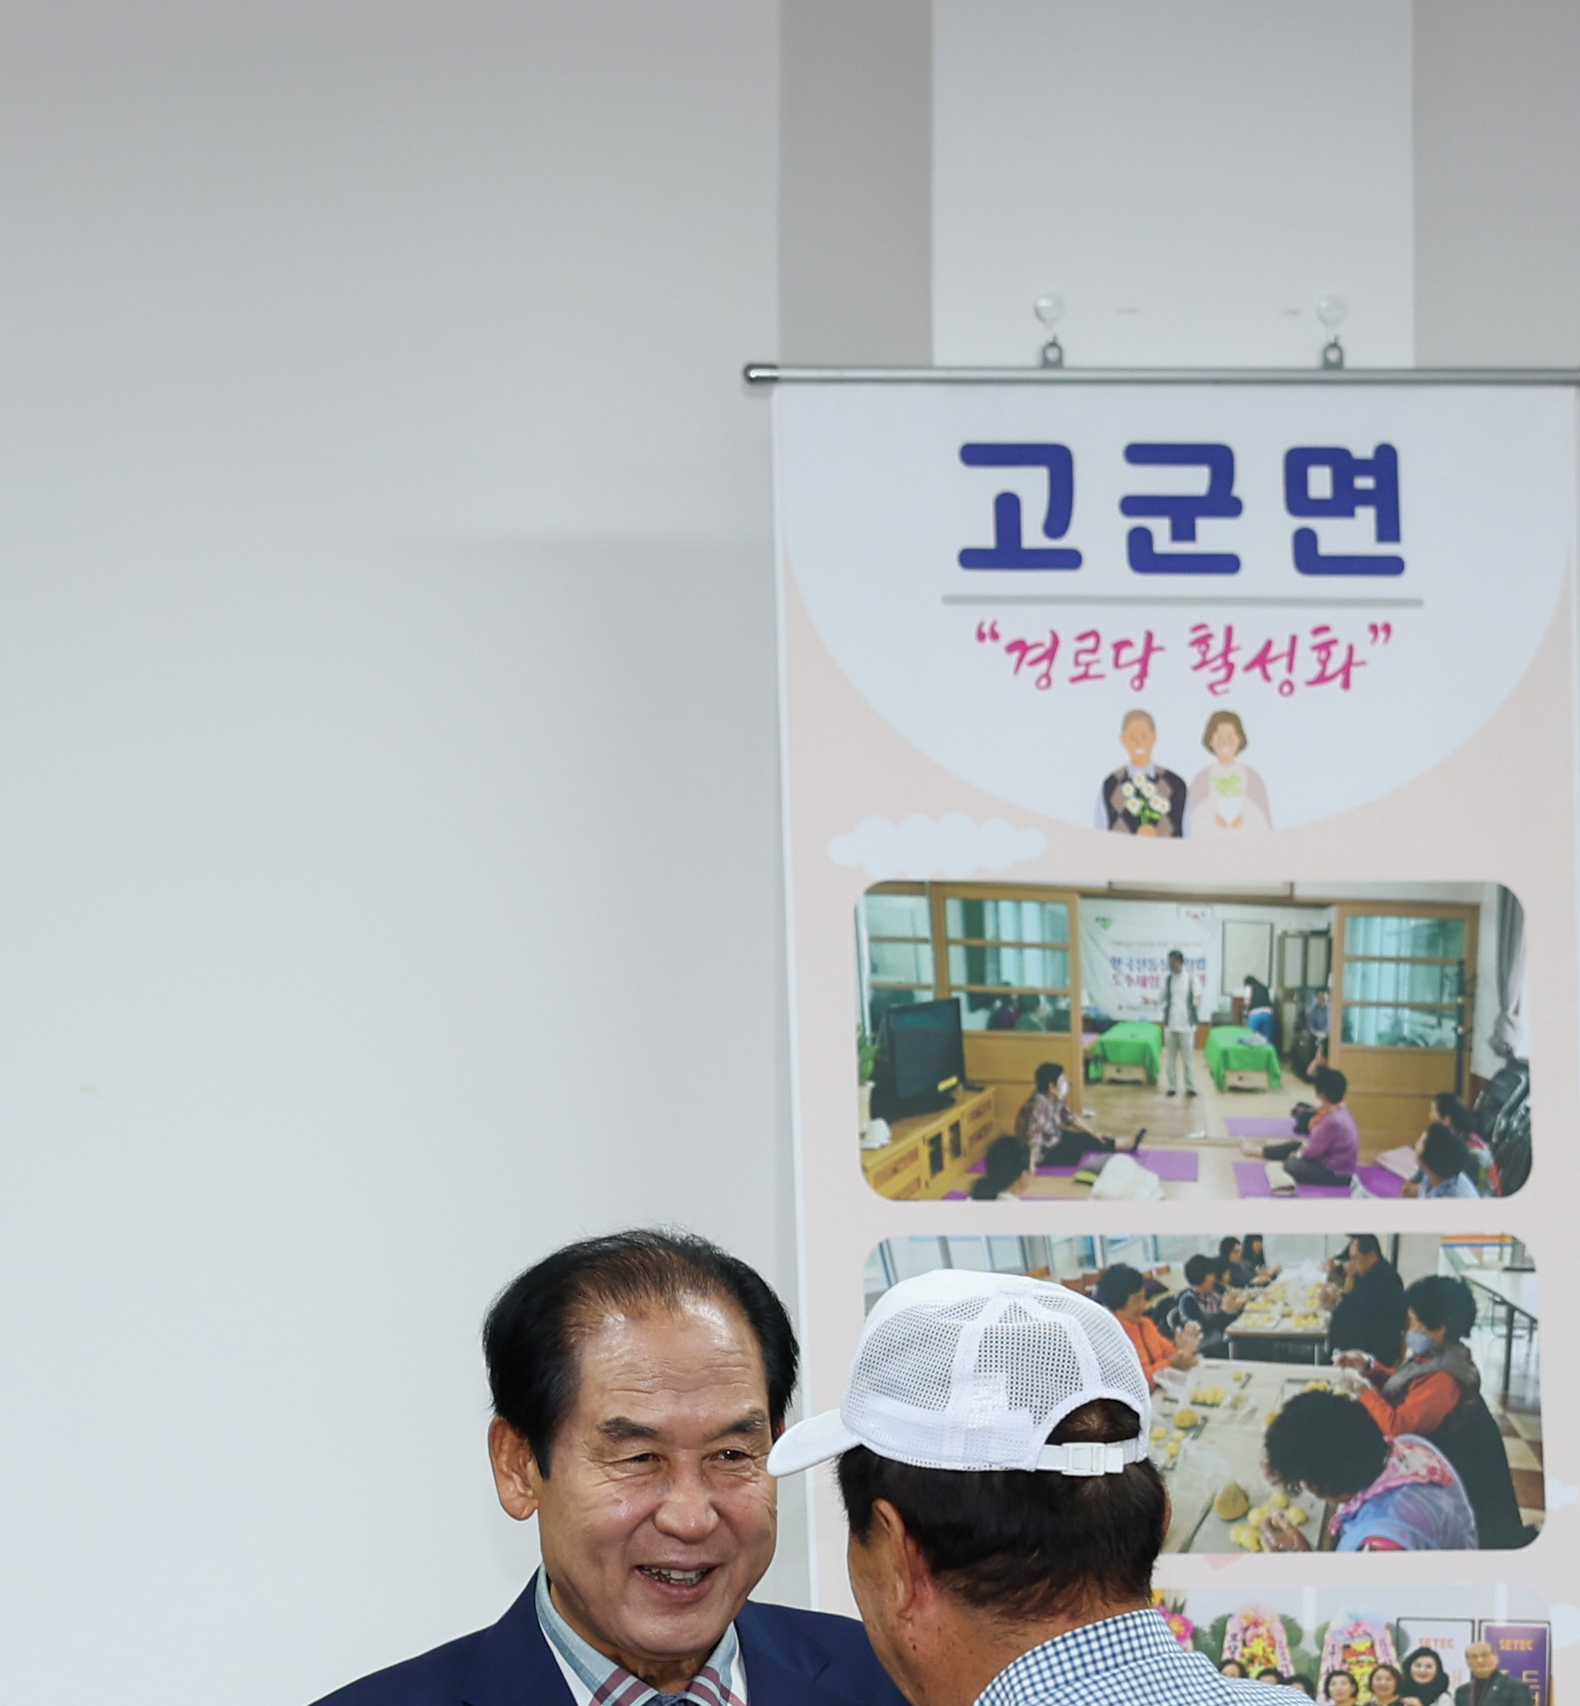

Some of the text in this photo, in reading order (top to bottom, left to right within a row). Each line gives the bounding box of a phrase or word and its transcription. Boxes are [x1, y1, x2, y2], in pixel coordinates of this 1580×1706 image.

[957, 442, 1405, 577] 고군면
[976, 620, 1393, 698] “경로당 활성화”
[1499, 1639, 1533, 1651] SETEC
